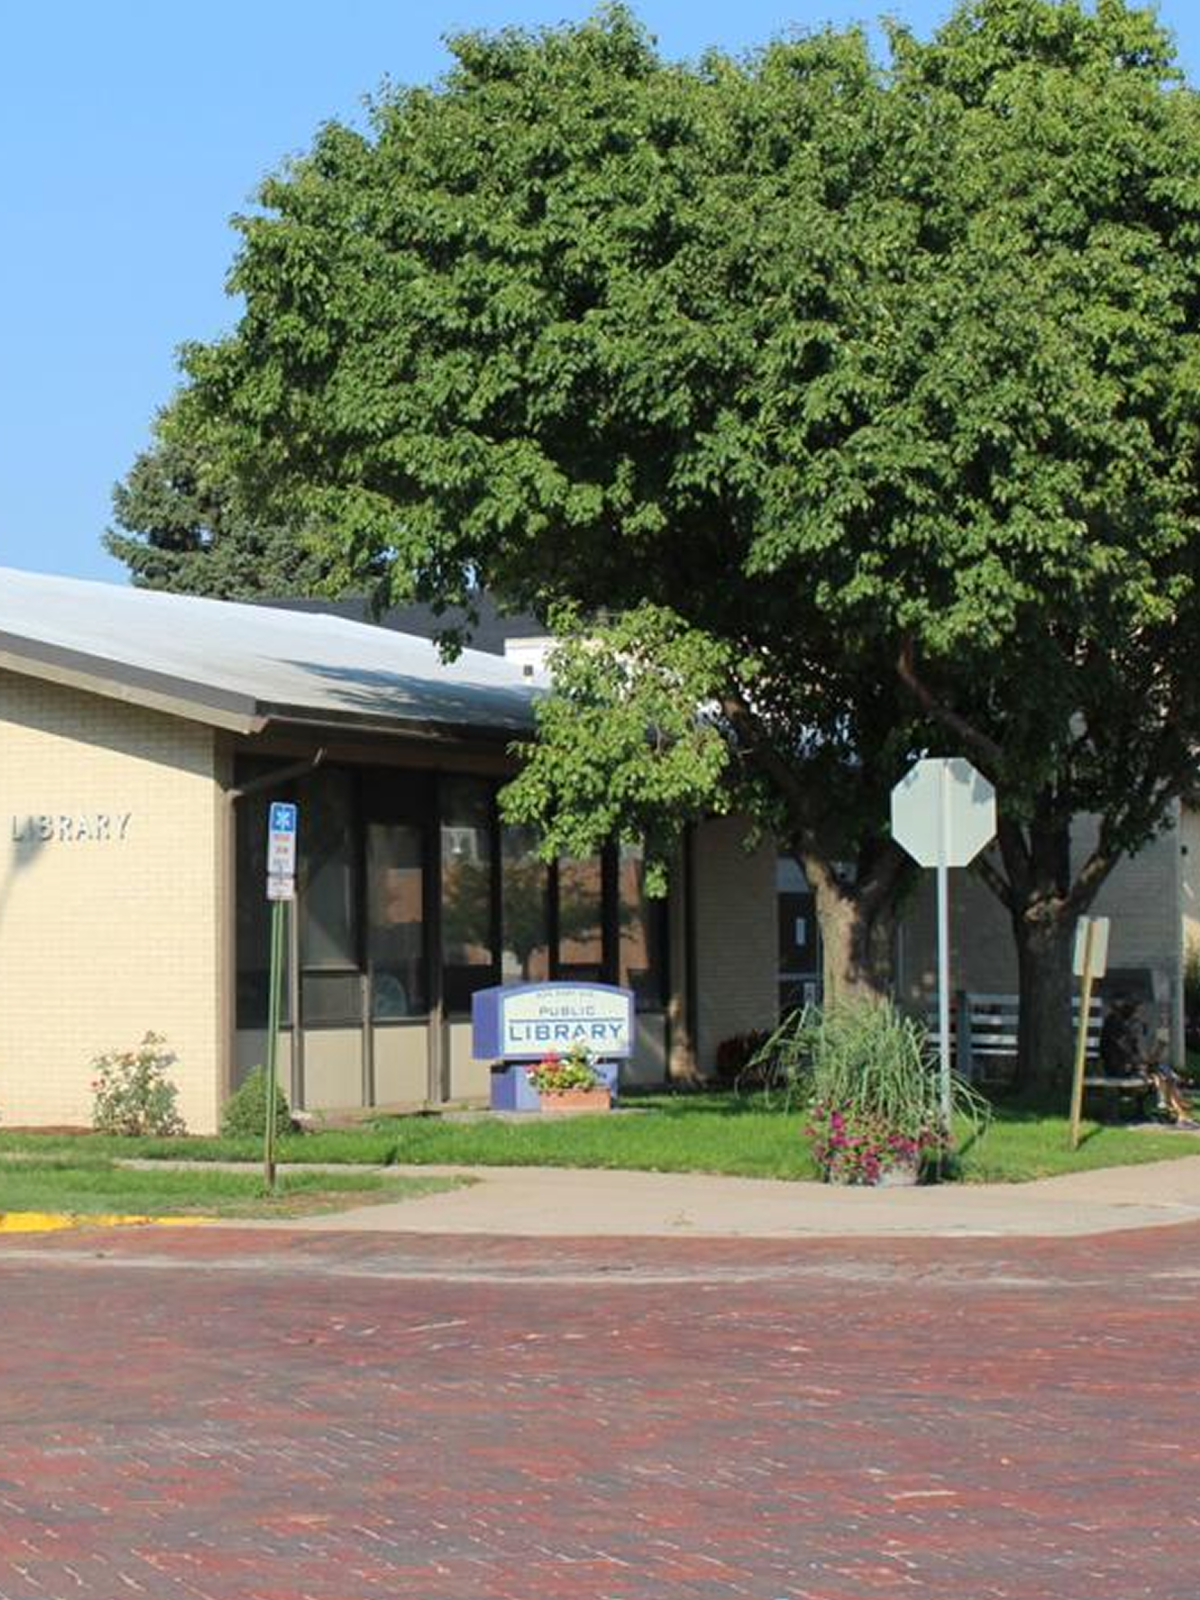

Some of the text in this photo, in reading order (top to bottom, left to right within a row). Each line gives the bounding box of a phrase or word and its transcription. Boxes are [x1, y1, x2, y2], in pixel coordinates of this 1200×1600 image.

[11, 812, 131, 843] LIBRARY
[539, 1005, 596, 1017] PUBLIC
[509, 1023, 623, 1042] LIBRARY
